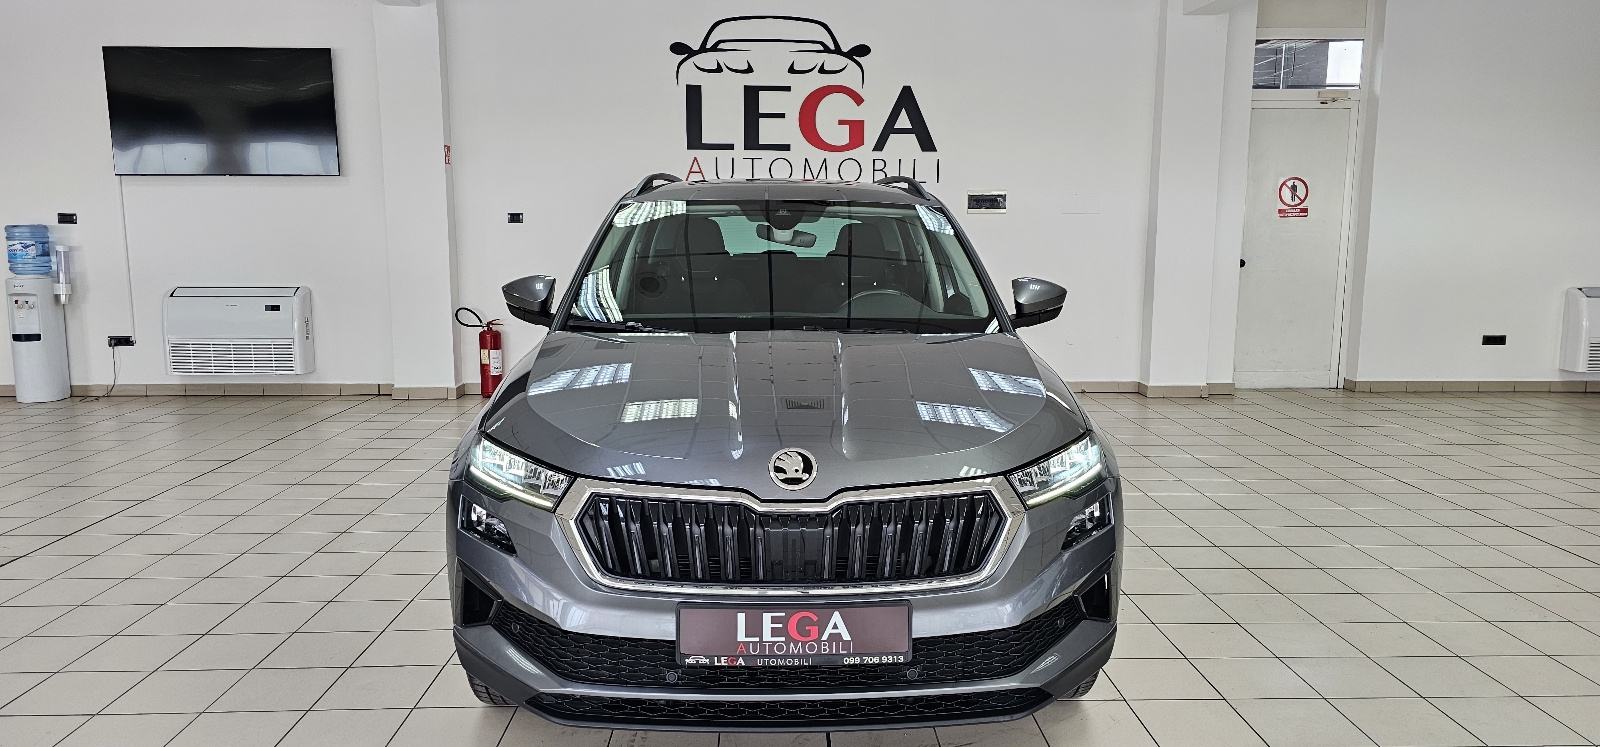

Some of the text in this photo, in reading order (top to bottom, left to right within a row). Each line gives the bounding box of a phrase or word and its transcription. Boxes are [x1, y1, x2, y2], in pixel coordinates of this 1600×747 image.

[685, 84, 938, 153] LEGA
[685, 156, 940, 184] AUTOMOBILI
[736, 610, 852, 642] LEGA
[714, 655, 904, 667] LEGA UTOMOBILI 099 706 9313
[736, 641, 853, 655] AUTOMOBILI
